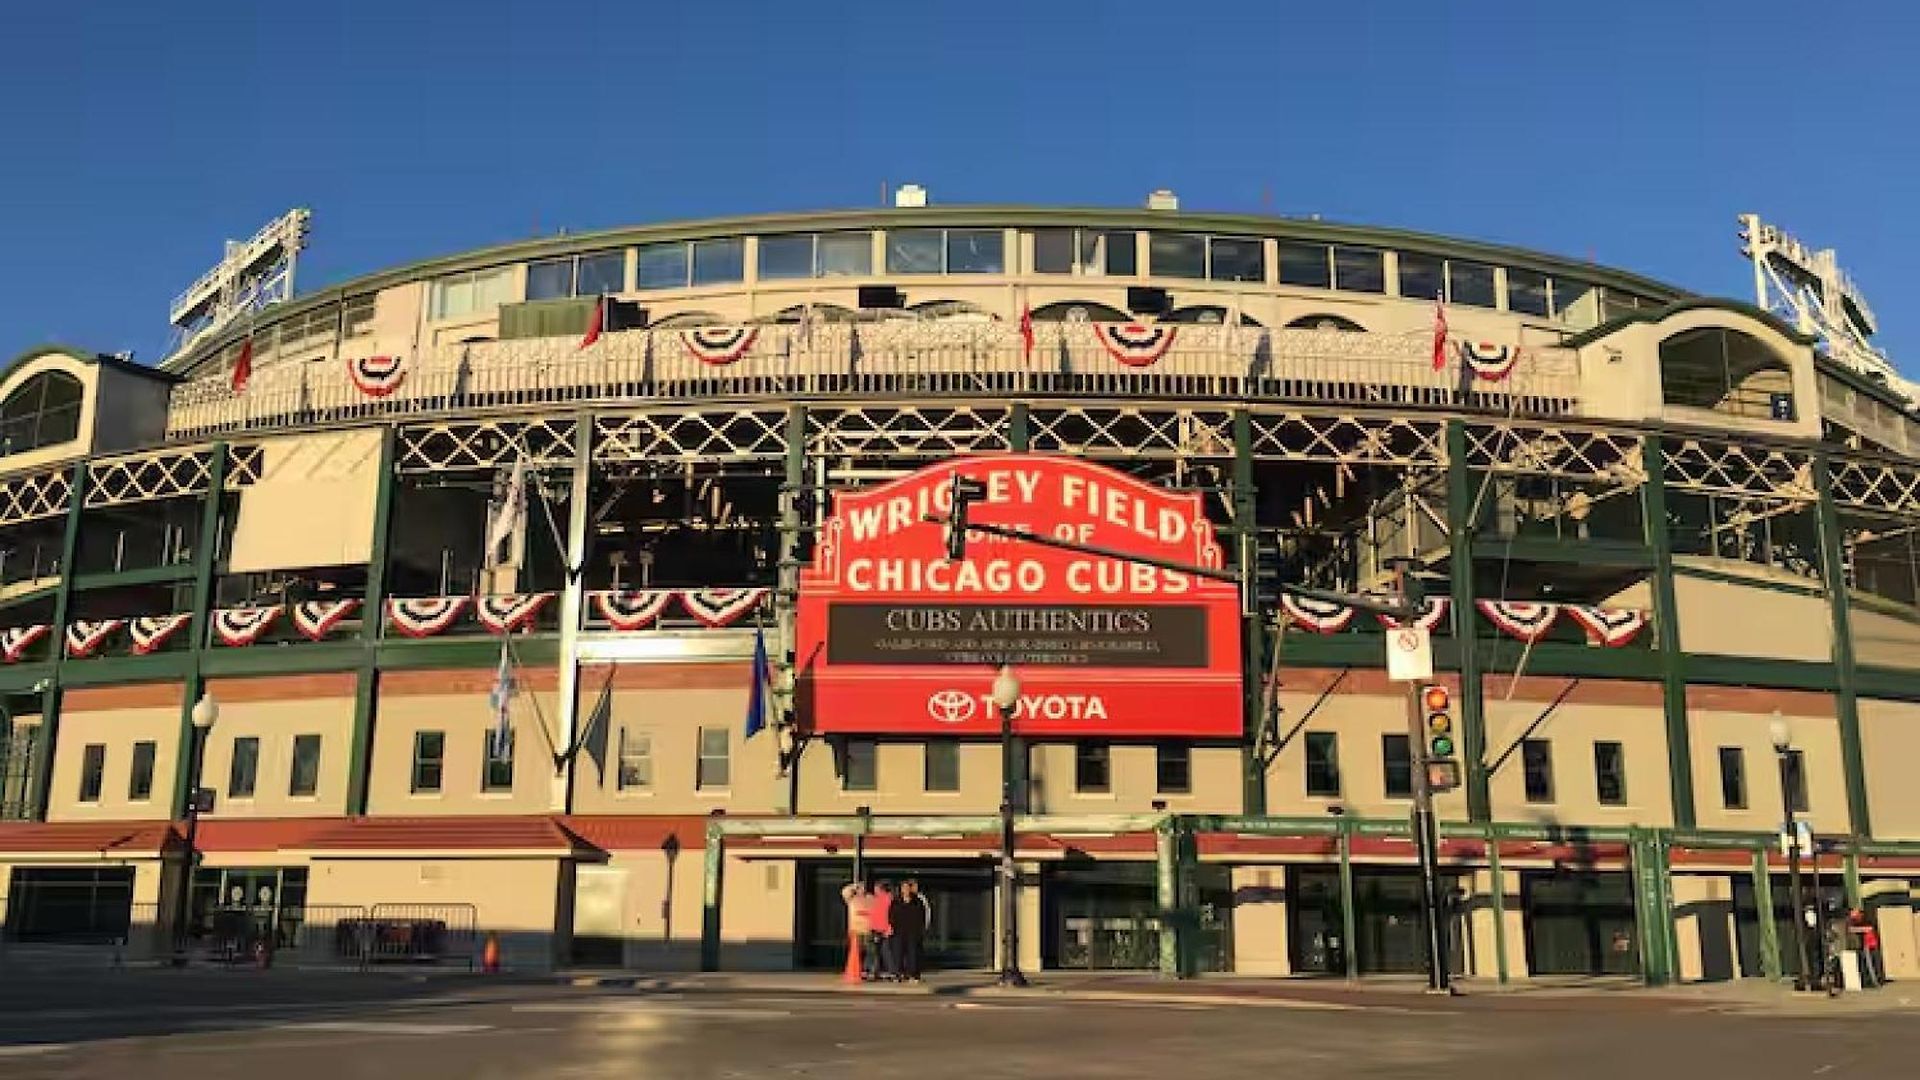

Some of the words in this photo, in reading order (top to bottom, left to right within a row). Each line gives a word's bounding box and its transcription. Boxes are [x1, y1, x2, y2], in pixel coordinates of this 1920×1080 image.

[850, 470, 1043, 542] WRIGEY
[1063, 474, 1187, 543] FIELD
[942, 523, 1033, 544] OME
[1055, 523, 1096, 544] OF
[847, 558, 1046, 593] CHICAGO
[1066, 560, 1190, 594] CUBS
[886, 609, 961, 632] CUBS
[968, 609, 1151, 632] AUTHENTICS
[981, 694, 1108, 720] TYOTA
